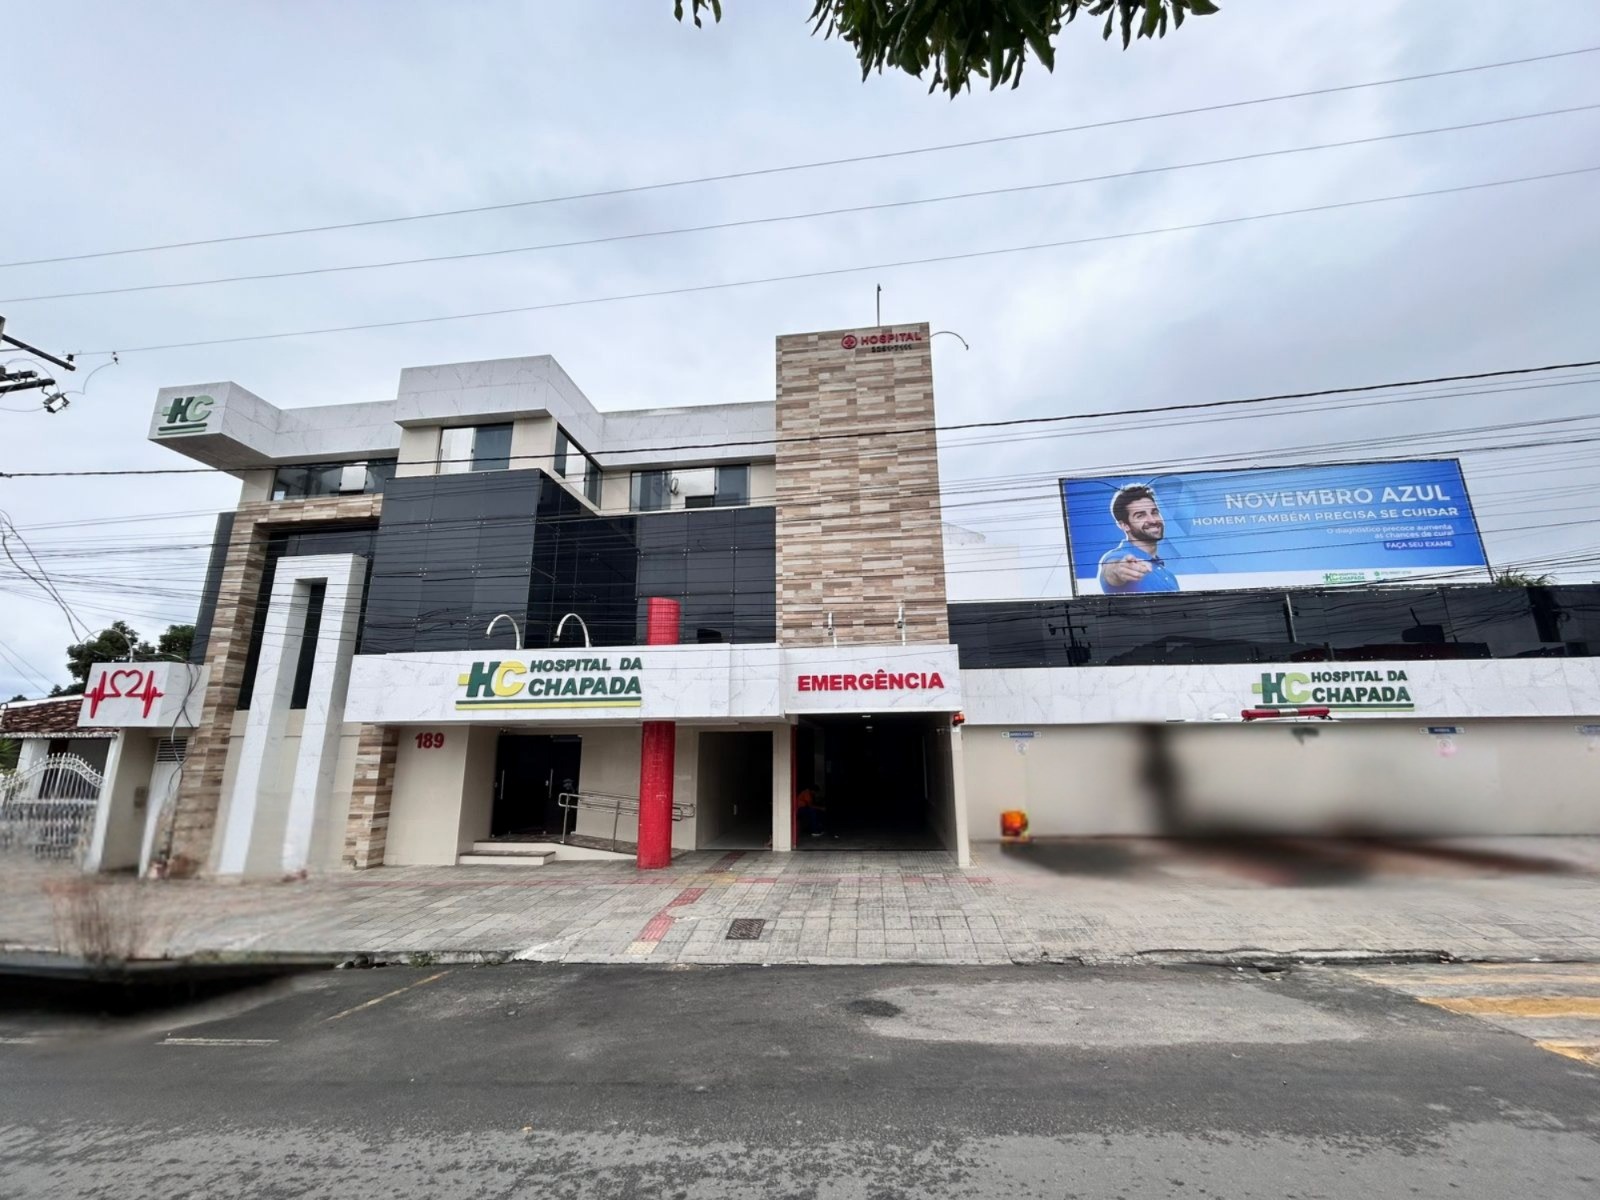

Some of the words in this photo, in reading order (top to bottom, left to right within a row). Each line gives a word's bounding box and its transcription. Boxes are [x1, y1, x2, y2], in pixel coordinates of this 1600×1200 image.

[860, 332, 922, 346] HOSPITAL
[166, 394, 214, 424] HC
[1225, 487, 1374, 509] NOVEMBRO
[1381, 485, 1450, 503] AZUL
[1192, 515, 1247, 526] HOMEM
[1249, 511, 1311, 523] TAMBÉM
[1314, 510, 1377, 521] PRECISA
[1380, 508, 1397, 518] SE
[1401, 507, 1459, 517] CUIDAR
[1386, 541, 1407, 549] FAÇA
[530, 658, 612, 673] HOSPITAL
[619, 657, 643, 670] DA
[465, 660, 527, 698] HC
[797, 668, 945, 692] EMERGÊNCIA
[1311, 670, 1383, 683] HOSPITAL
[1387, 670, 1408, 681] DA
[528, 676, 642, 697] CHAPADA
[1261, 672, 1312, 703] HC
[1312, 686, 1412, 703] CHAPADA
[415, 732, 445, 749] 189
